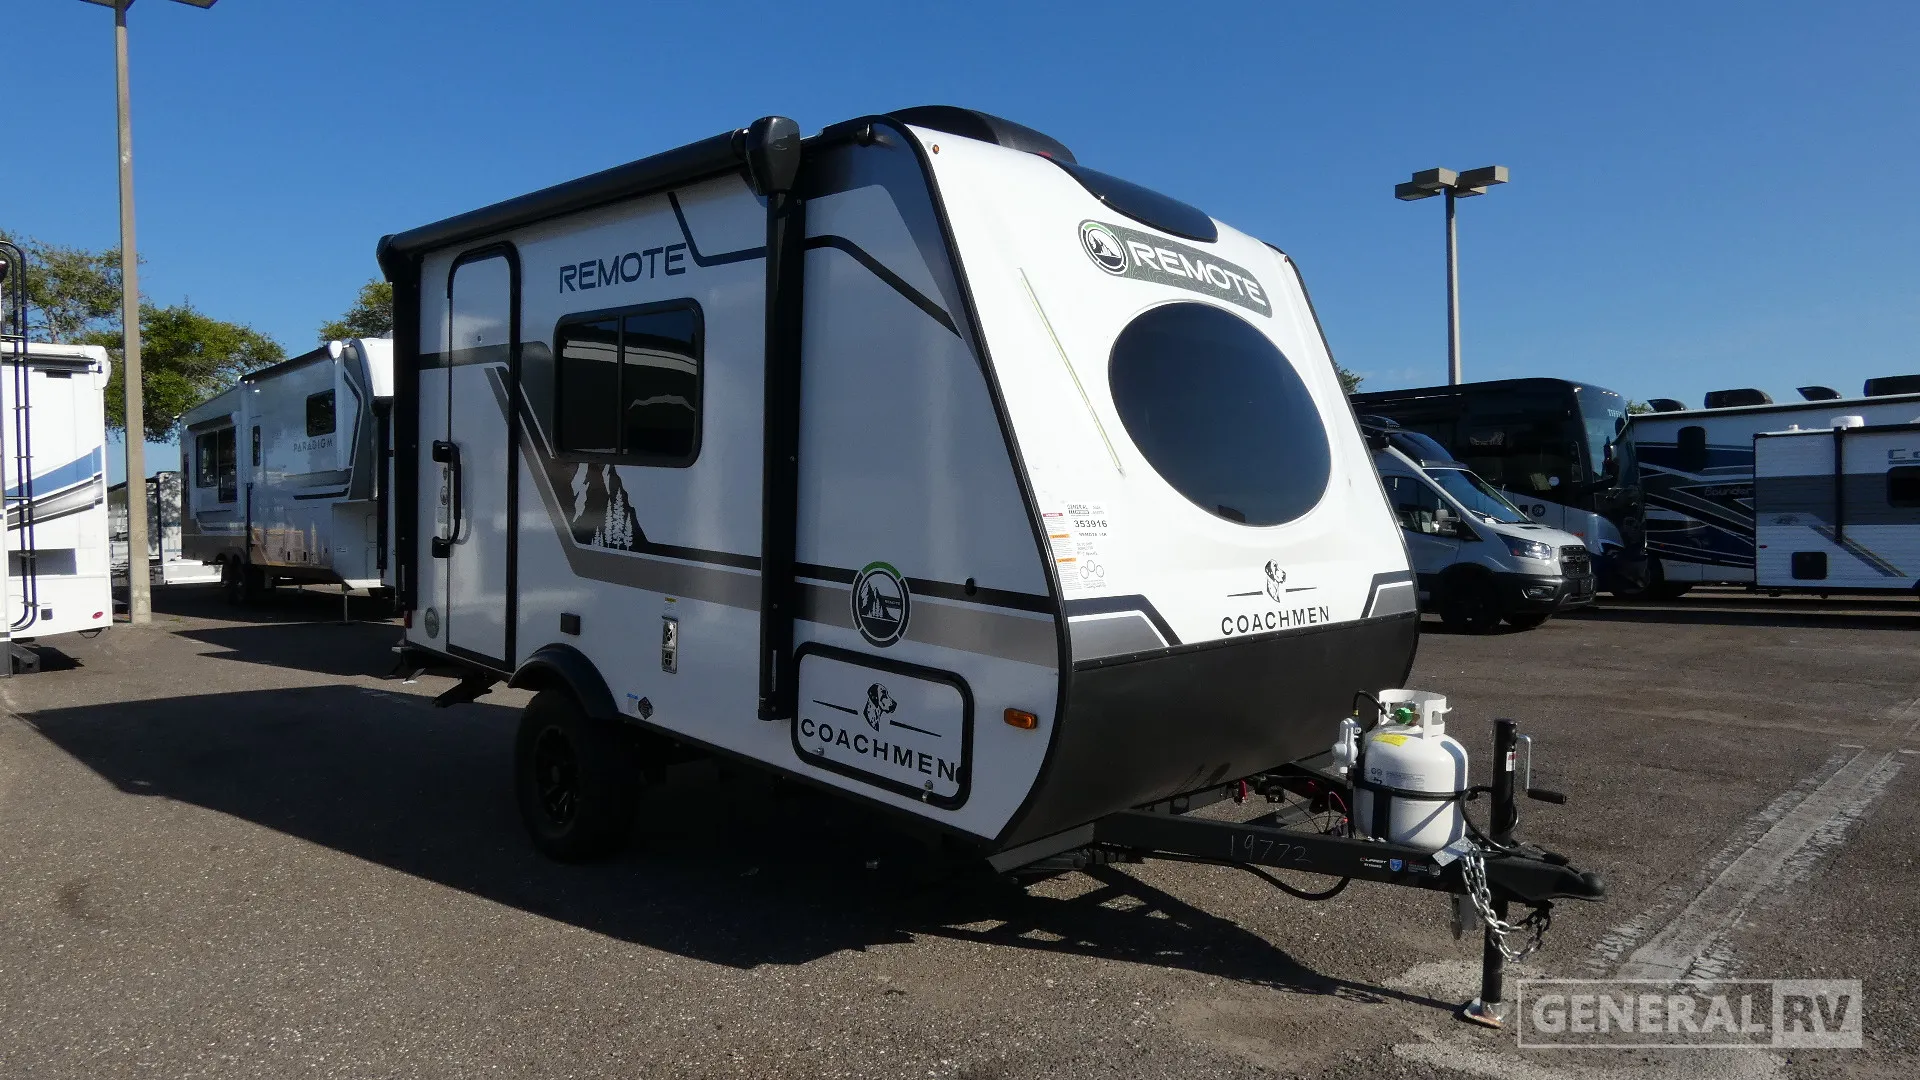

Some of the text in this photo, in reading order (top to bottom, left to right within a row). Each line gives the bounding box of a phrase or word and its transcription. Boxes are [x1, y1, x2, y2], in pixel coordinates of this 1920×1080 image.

[559, 242, 687, 294] REMOTE
[1125, 240, 1267, 307] REMOTE
[293, 438, 333, 452] PARADIGM
[1073, 519, 1108, 528] 353916
[1221, 605, 1330, 635] COACHMEN
[800, 718, 956, 782] COACHMEN
[1230, 834, 1313, 864] 19772
